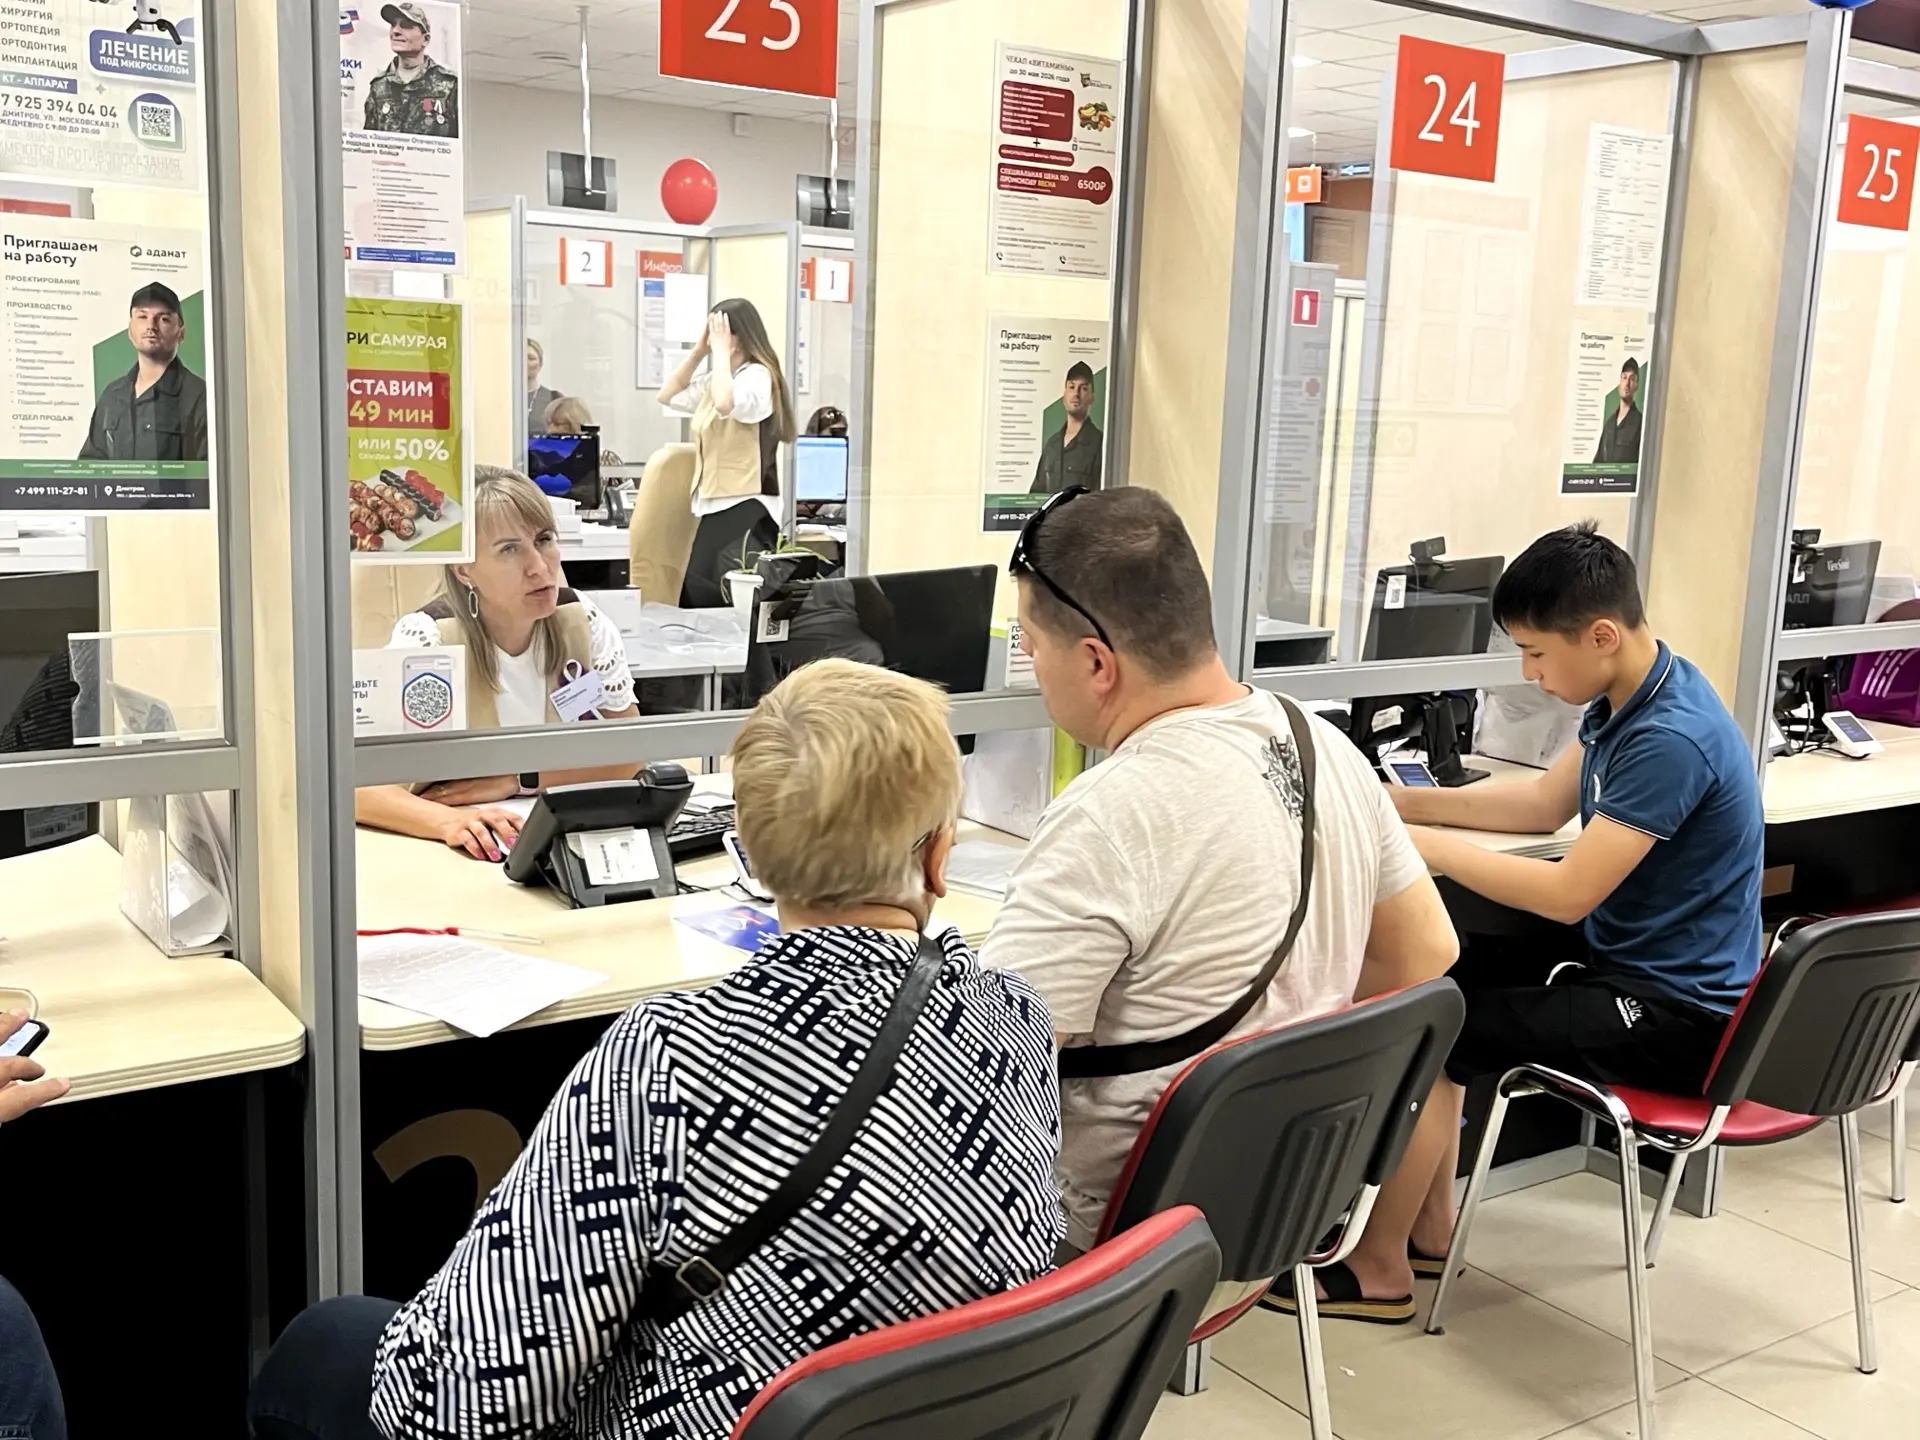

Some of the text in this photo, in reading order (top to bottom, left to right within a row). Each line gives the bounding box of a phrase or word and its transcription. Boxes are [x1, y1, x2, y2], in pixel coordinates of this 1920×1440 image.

[1, 6, 53, 20] ХИРУРГИЯ
[1, 21, 60, 36] ОРТОПЕДИЯ
[1, 38, 67, 53] ОРТОДОНТИЯ
[99, 39, 189, 66] ЛЕЧЕНИЕ
[2, 54, 78, 71] ИМПЛАНТАЦИЯ
[99, 56, 189, 75] ПОД МИКРОСКОПОМ
[2, 74, 15, 83] КТ
[24, 76, 69, 90] АППАРАТ
[1, 93, 118, 118] 7 925 394 04 04
[1417, 74, 1481, 147] 24
[59, 116, 110, 128] МОСКОВСКАЯ
[1856, 143, 1902, 203] 25
[4, 234, 98, 252] Приглашаем
[4, 252, 77, 267] на работу
[146, 248, 187, 259] аданат
[580, 251, 592, 272] 2
[5, 275, 80, 286] ПРОЕКТИРОВАНИЕ
[829, 269, 837, 290] 1
[6, 301, 72, 311] ПРОИЗВОДСТВО
[1000, 329, 1052, 341] Приглашаем
[1010, 341, 1040, 352] работу
[347, 378, 433, 397] СТАВИМ
[12, 414, 74, 422] ОТДЕЛ ПРОДАЖ
[350, 400, 381, 421] 49
[393, 437, 450, 461] 50%
[15, 486, 88, 496] +7 499 111-27-81
